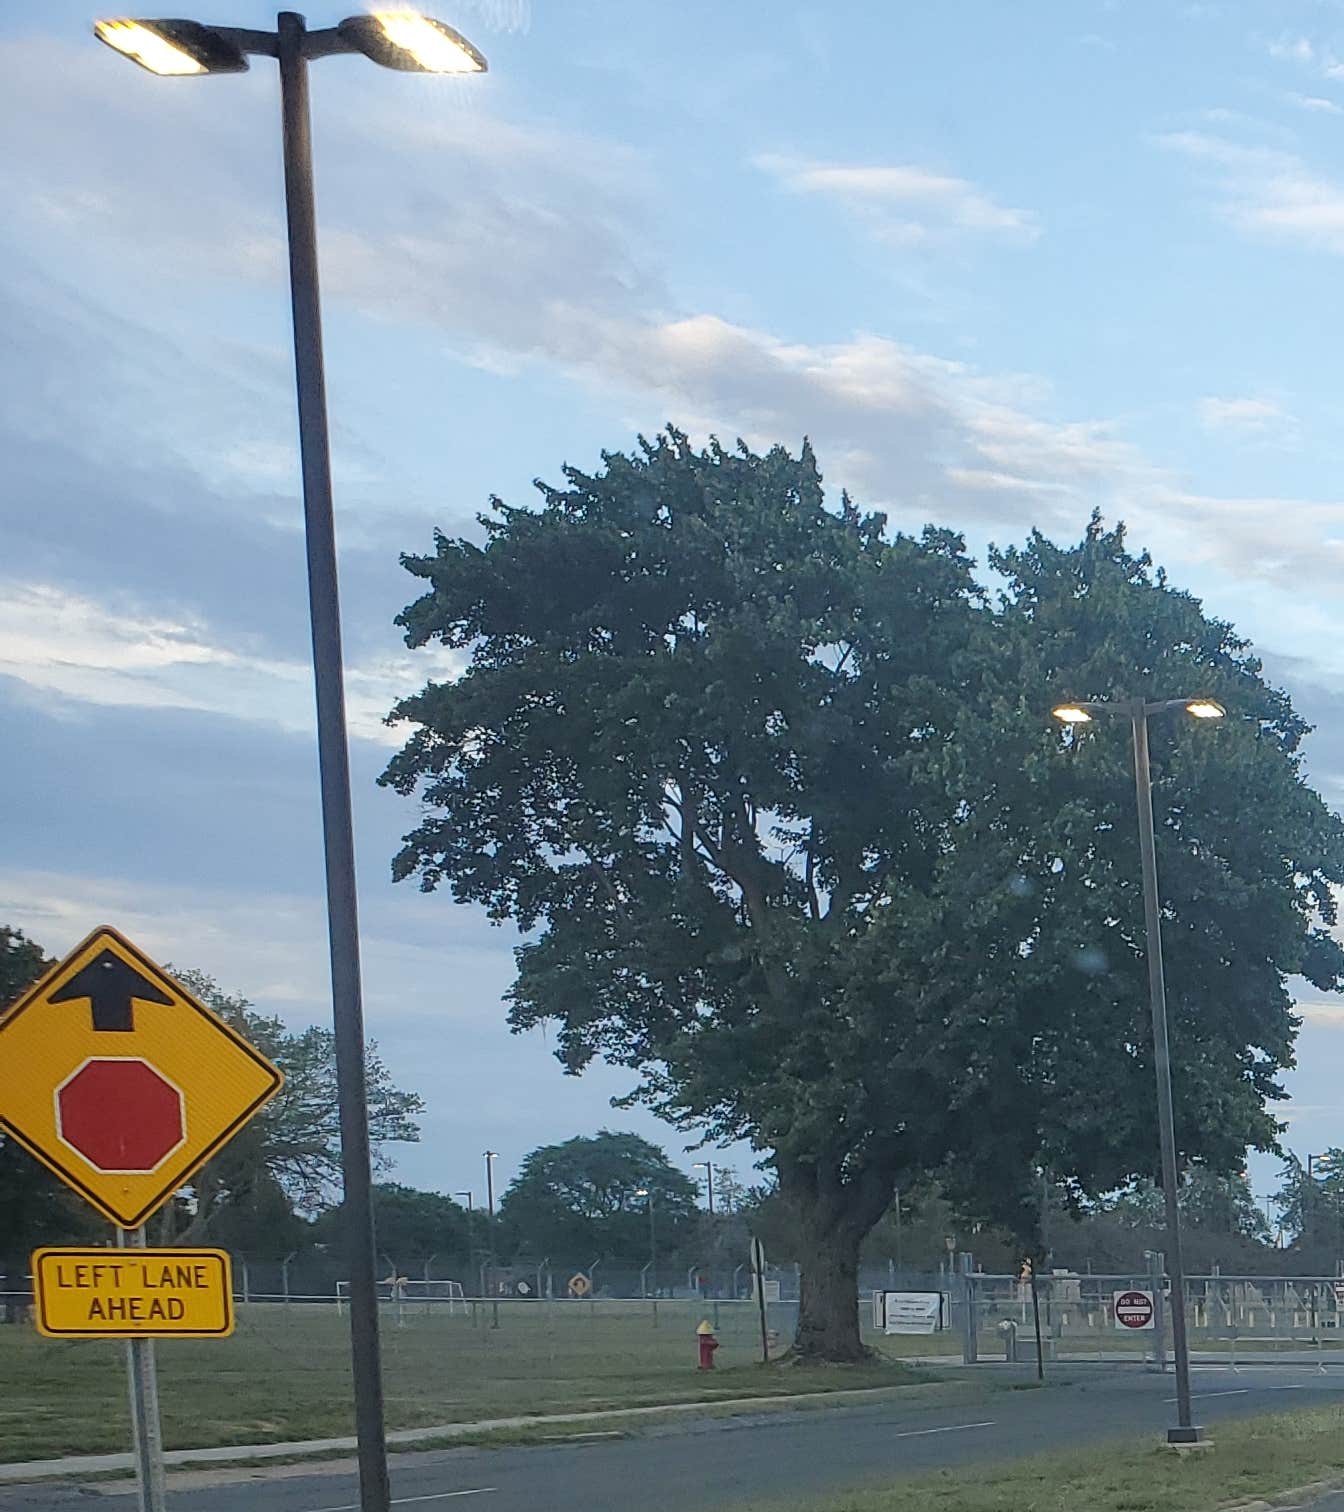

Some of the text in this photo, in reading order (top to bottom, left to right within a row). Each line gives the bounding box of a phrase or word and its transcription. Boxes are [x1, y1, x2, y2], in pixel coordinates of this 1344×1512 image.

[57, 1265, 209, 1288] LEFT LANE
[88, 1297, 185, 1320] AHEAD
